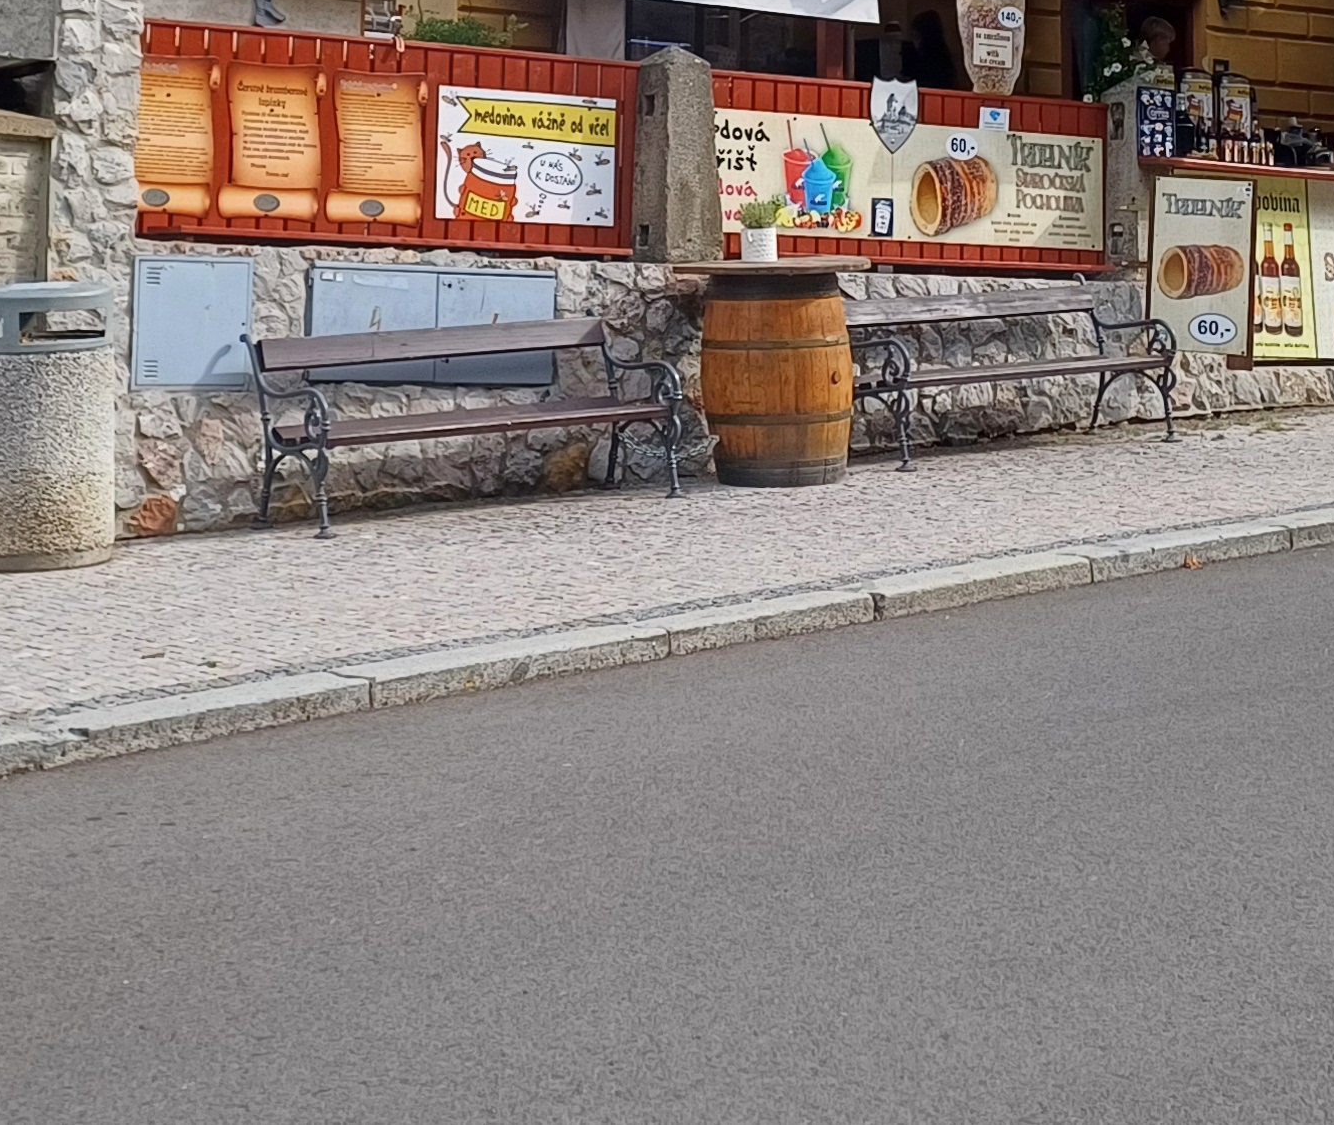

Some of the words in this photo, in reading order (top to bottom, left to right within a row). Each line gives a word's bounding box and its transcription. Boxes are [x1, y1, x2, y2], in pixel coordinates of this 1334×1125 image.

[1000, 10, 1022, 24] 140,-
[474, 105, 526, 128] medovina
[531, 110, 566, 132] vážně
[570, 115, 583, 134] od
[589, 116, 610, 137] včel
[714, 119, 770, 142] dová
[950, 136, 975, 156] 60,-
[716, 145, 757, 172] říšť
[468, 196, 499, 217] MED
[1256, 191, 1301, 214] ovina
[1197, 320, 1231, 339] 60,-
